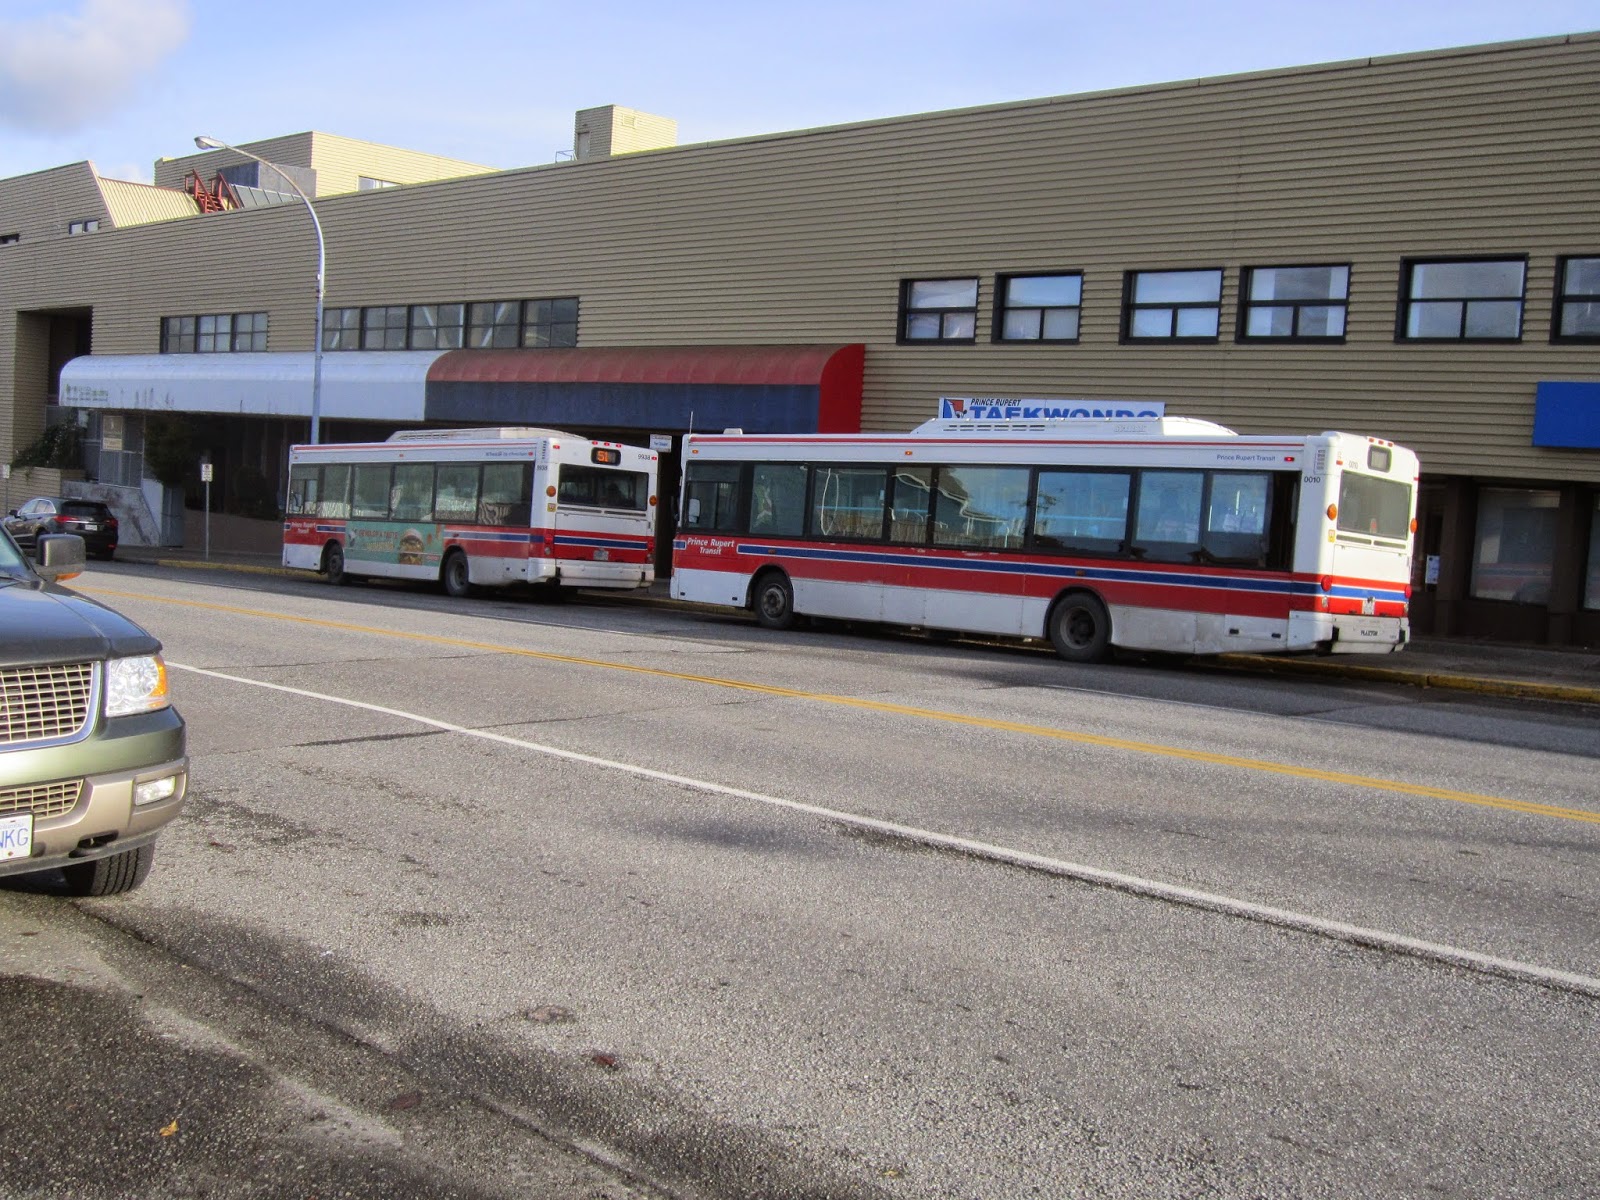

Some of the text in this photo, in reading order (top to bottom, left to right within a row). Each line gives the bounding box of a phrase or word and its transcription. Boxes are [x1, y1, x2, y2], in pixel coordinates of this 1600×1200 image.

[970, 398, 1021, 407] PRINCE RUPERT
[1236, 455, 1255, 463] Rupert
[687, 537, 735, 548] Prince Rupert
[699, 546, 722, 555] Transit
